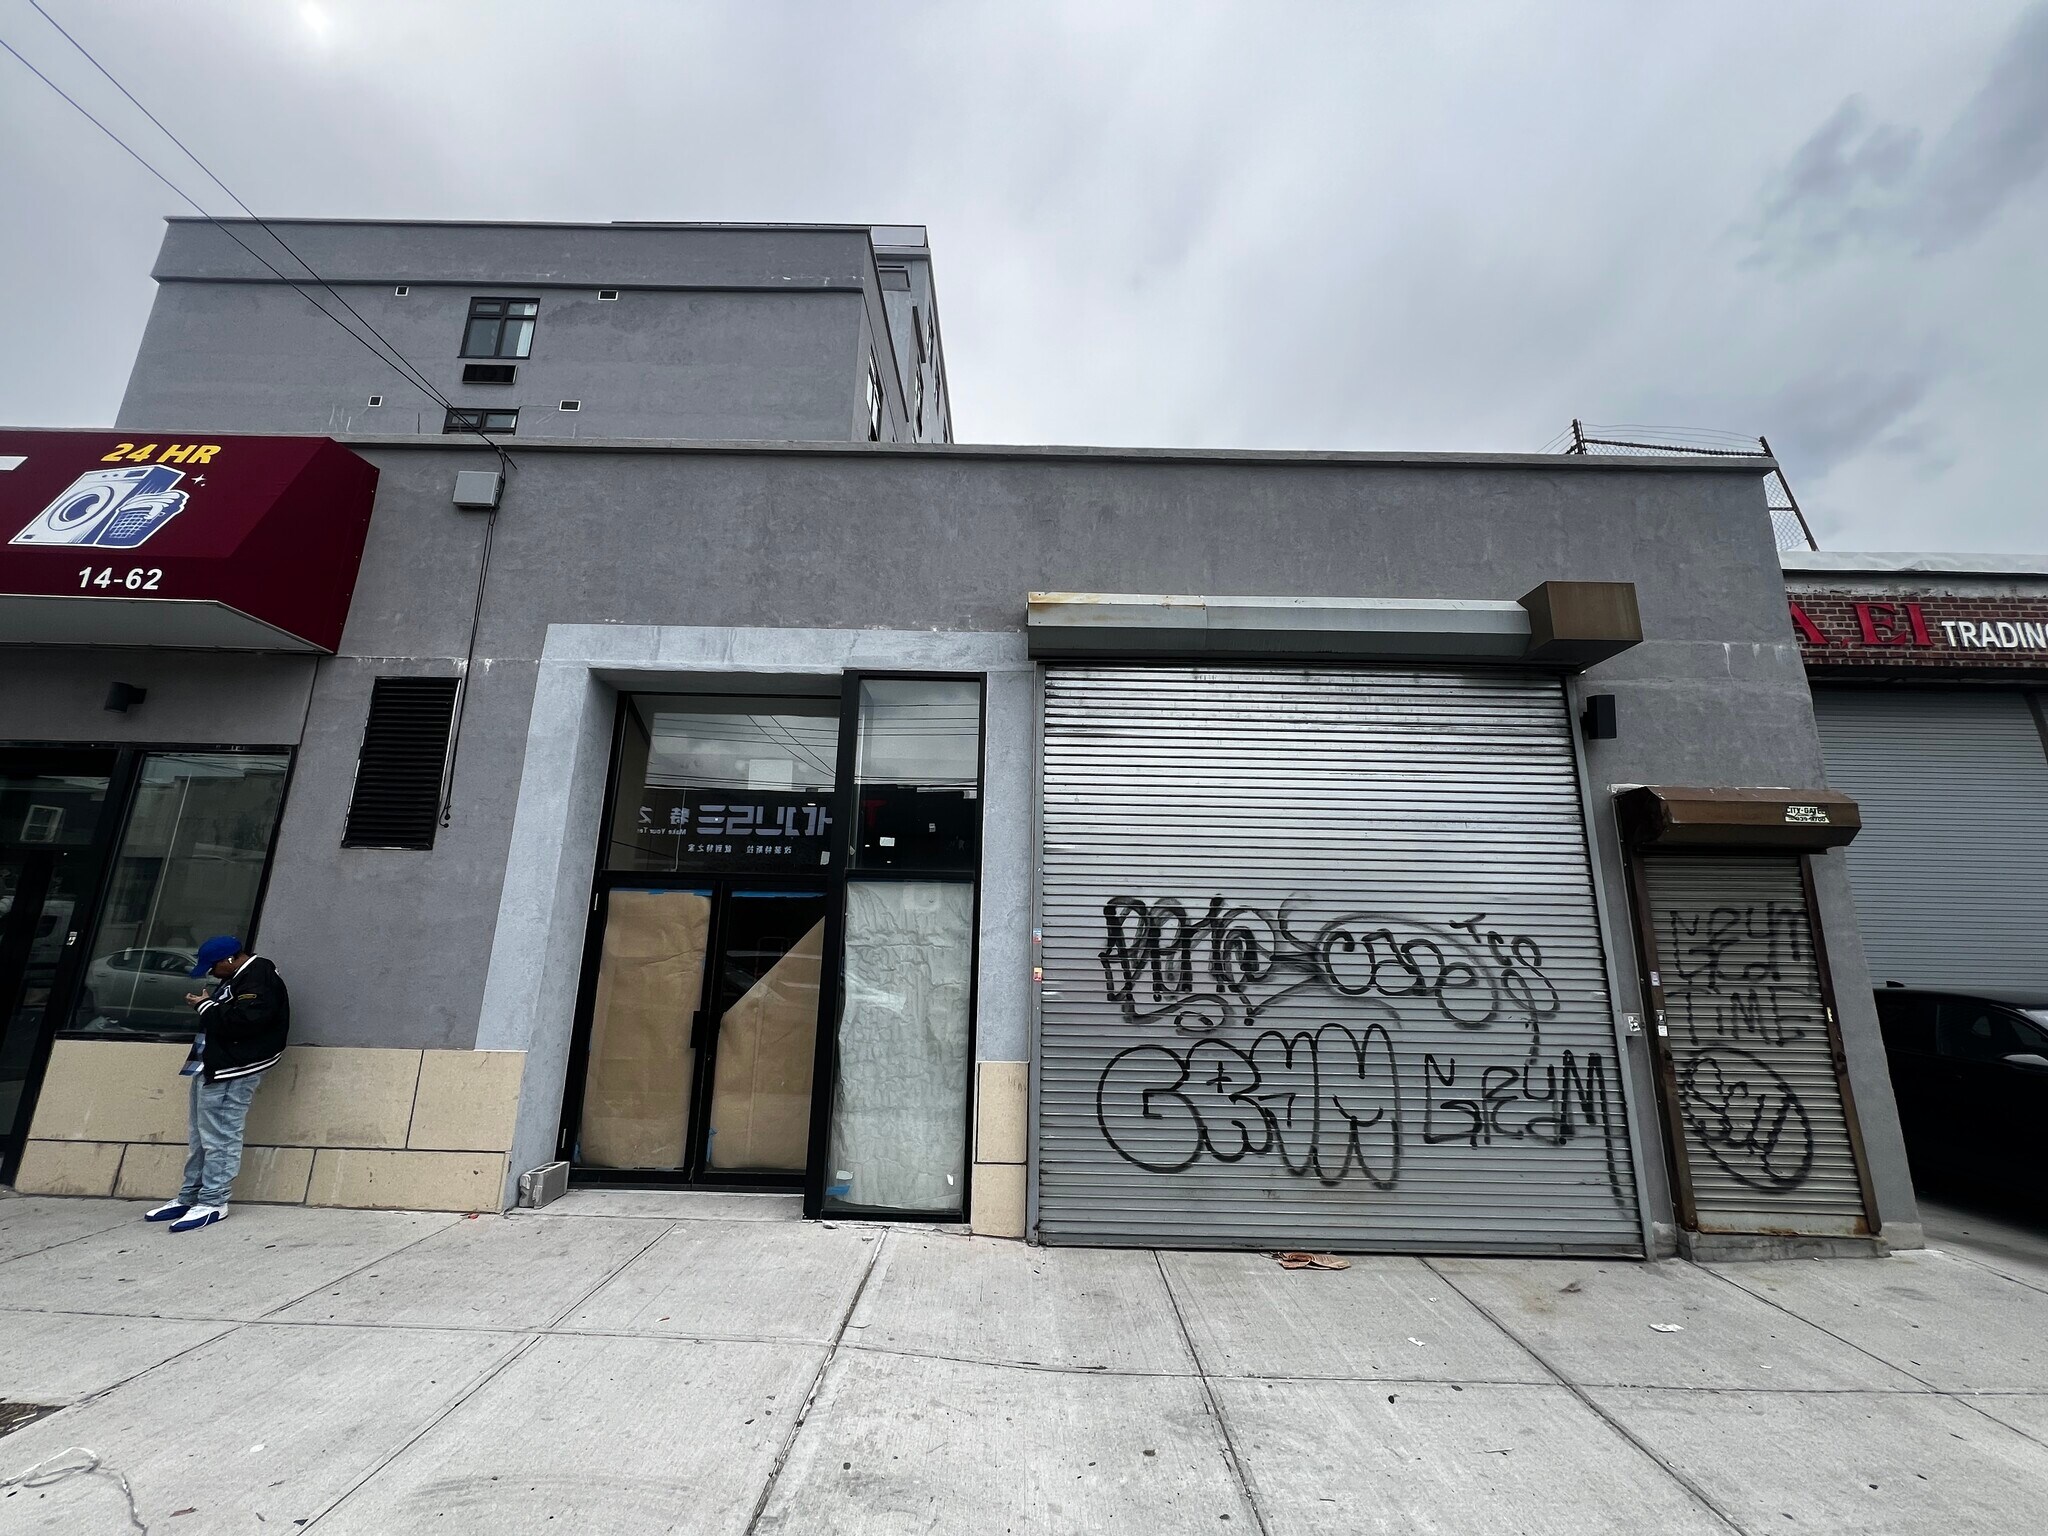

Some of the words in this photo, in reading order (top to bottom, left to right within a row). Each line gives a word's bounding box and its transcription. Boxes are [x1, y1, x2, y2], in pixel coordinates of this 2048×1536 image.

[101, 443, 157, 463] 24
[156, 444, 222, 464] HR
[77, 566, 163, 590] 14-62
[1940, 620, 2048, 649] TRADIN
